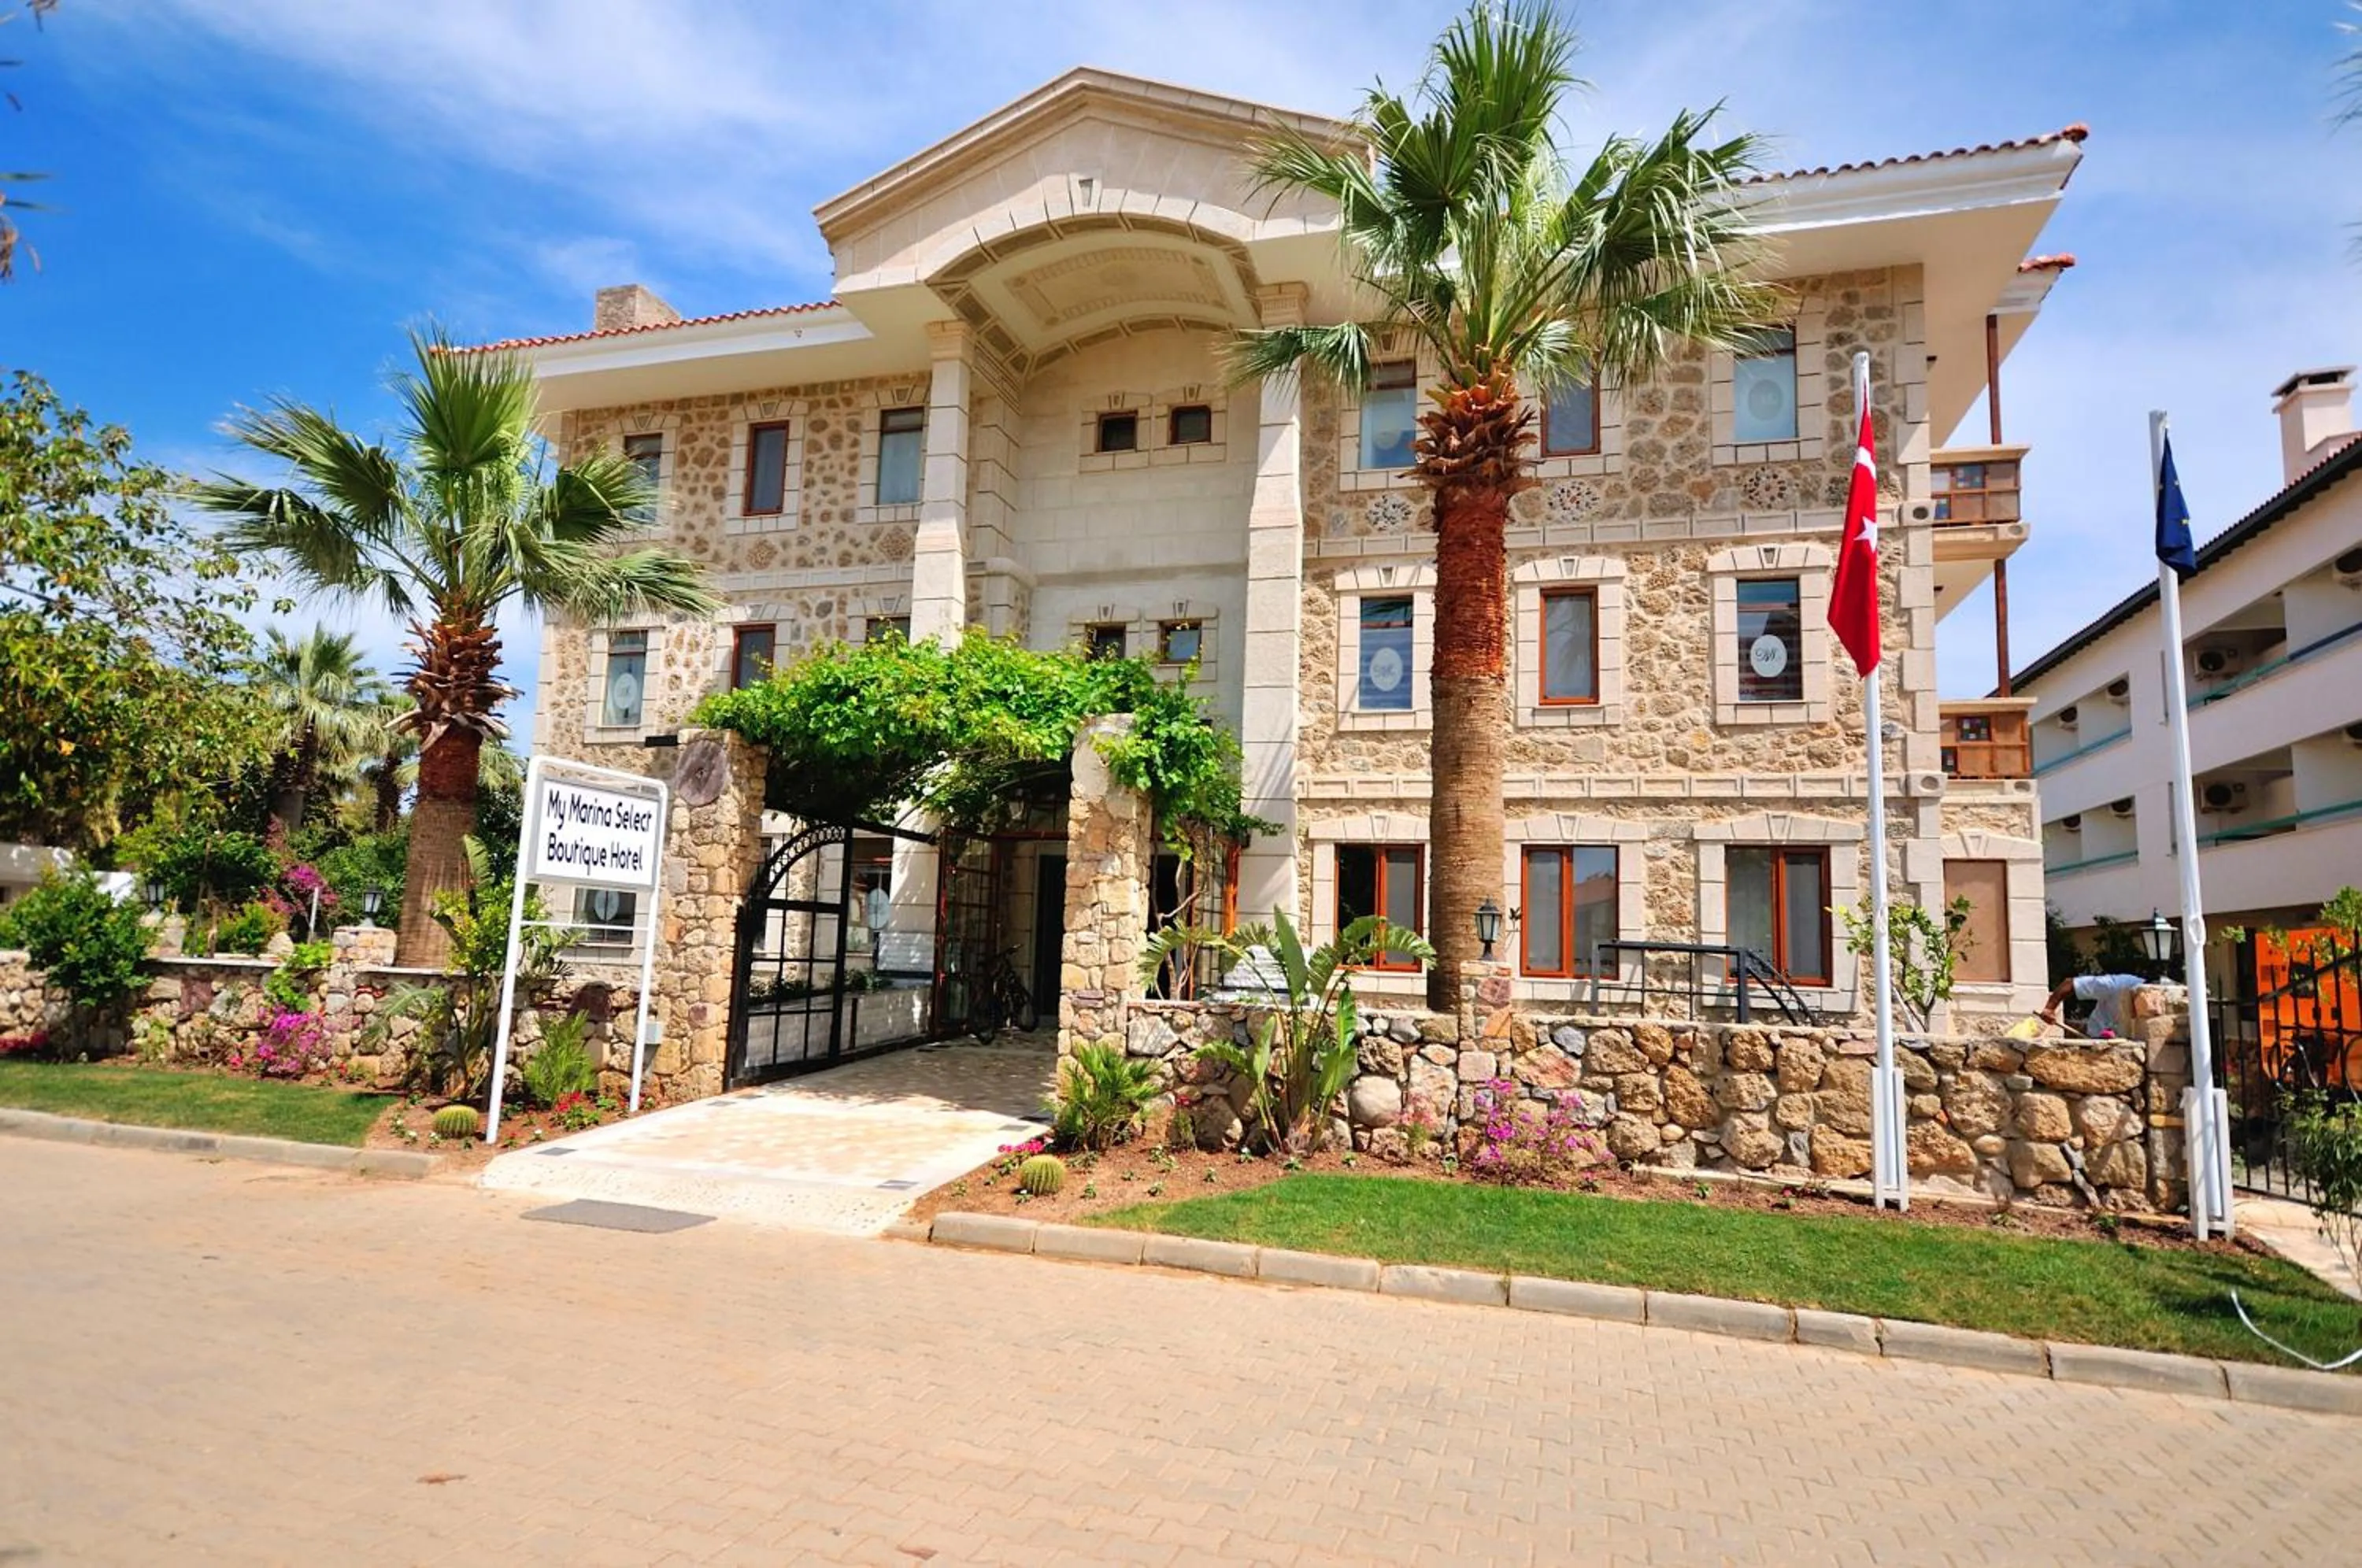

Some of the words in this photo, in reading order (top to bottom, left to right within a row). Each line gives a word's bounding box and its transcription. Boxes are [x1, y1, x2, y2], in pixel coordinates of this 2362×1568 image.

[546, 788, 566, 830] My
[568, 793, 612, 827] Marina
[615, 801, 652, 832] Select
[546, 832, 607, 875] Boutique
[610, 841, 643, 871] Hotel
